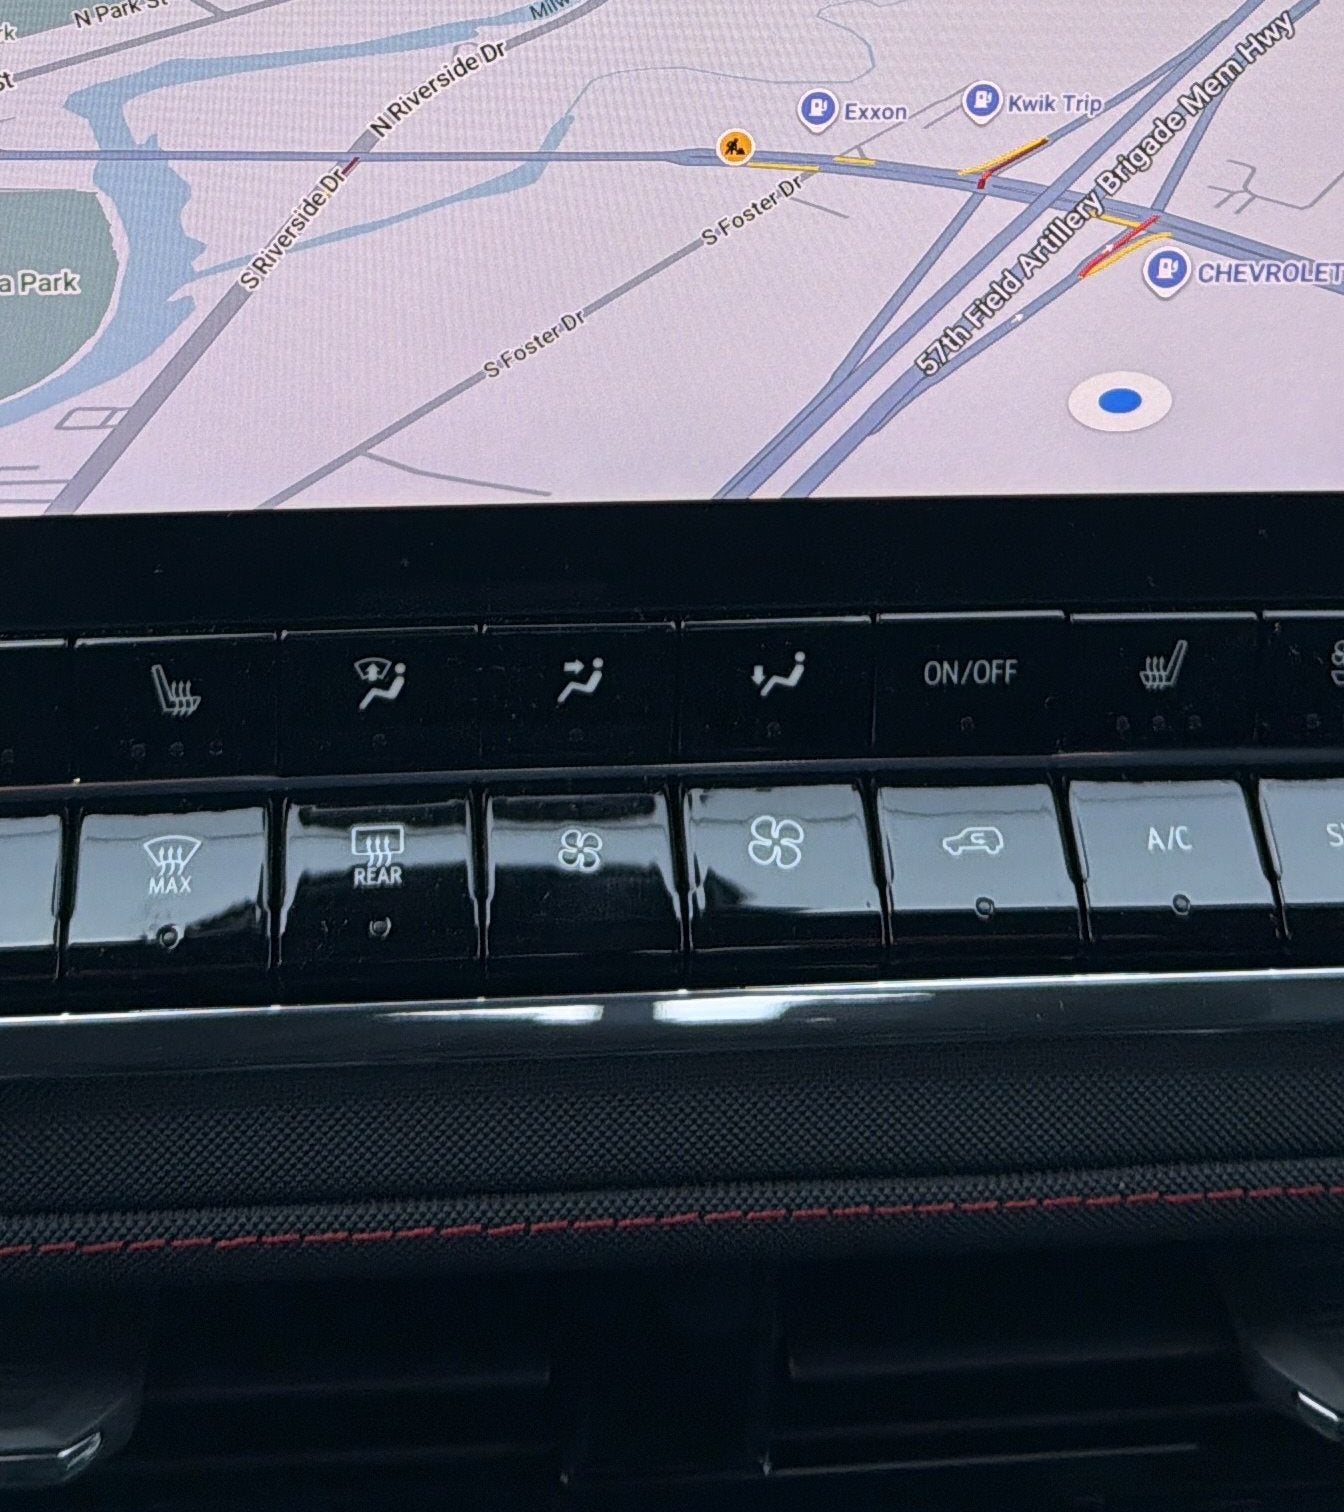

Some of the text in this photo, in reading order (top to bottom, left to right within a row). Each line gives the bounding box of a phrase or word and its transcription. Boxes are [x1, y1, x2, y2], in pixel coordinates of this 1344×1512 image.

[73, 11, 90, 29] N
[370, 39, 507, 139] N Riverside Dr
[845, 103, 908, 121] Exxon
[1008, 94, 1103, 115] Kwik Trip
[916, 11, 1296, 377] 57th Field Artillery Brigade Mem Hwy
[702, 177, 803, 246] S Foster Dr
[241, 167, 347, 292] S Riverside Dr
[19, 271, 78, 293] Park
[483, 310, 586, 378] S Foster Dr
[923, 658, 1018, 687] ON/OFF
[1147, 824, 1193, 851] A/C
[148, 875, 192, 896] MAX
[353, 866, 403, 889] REAR
